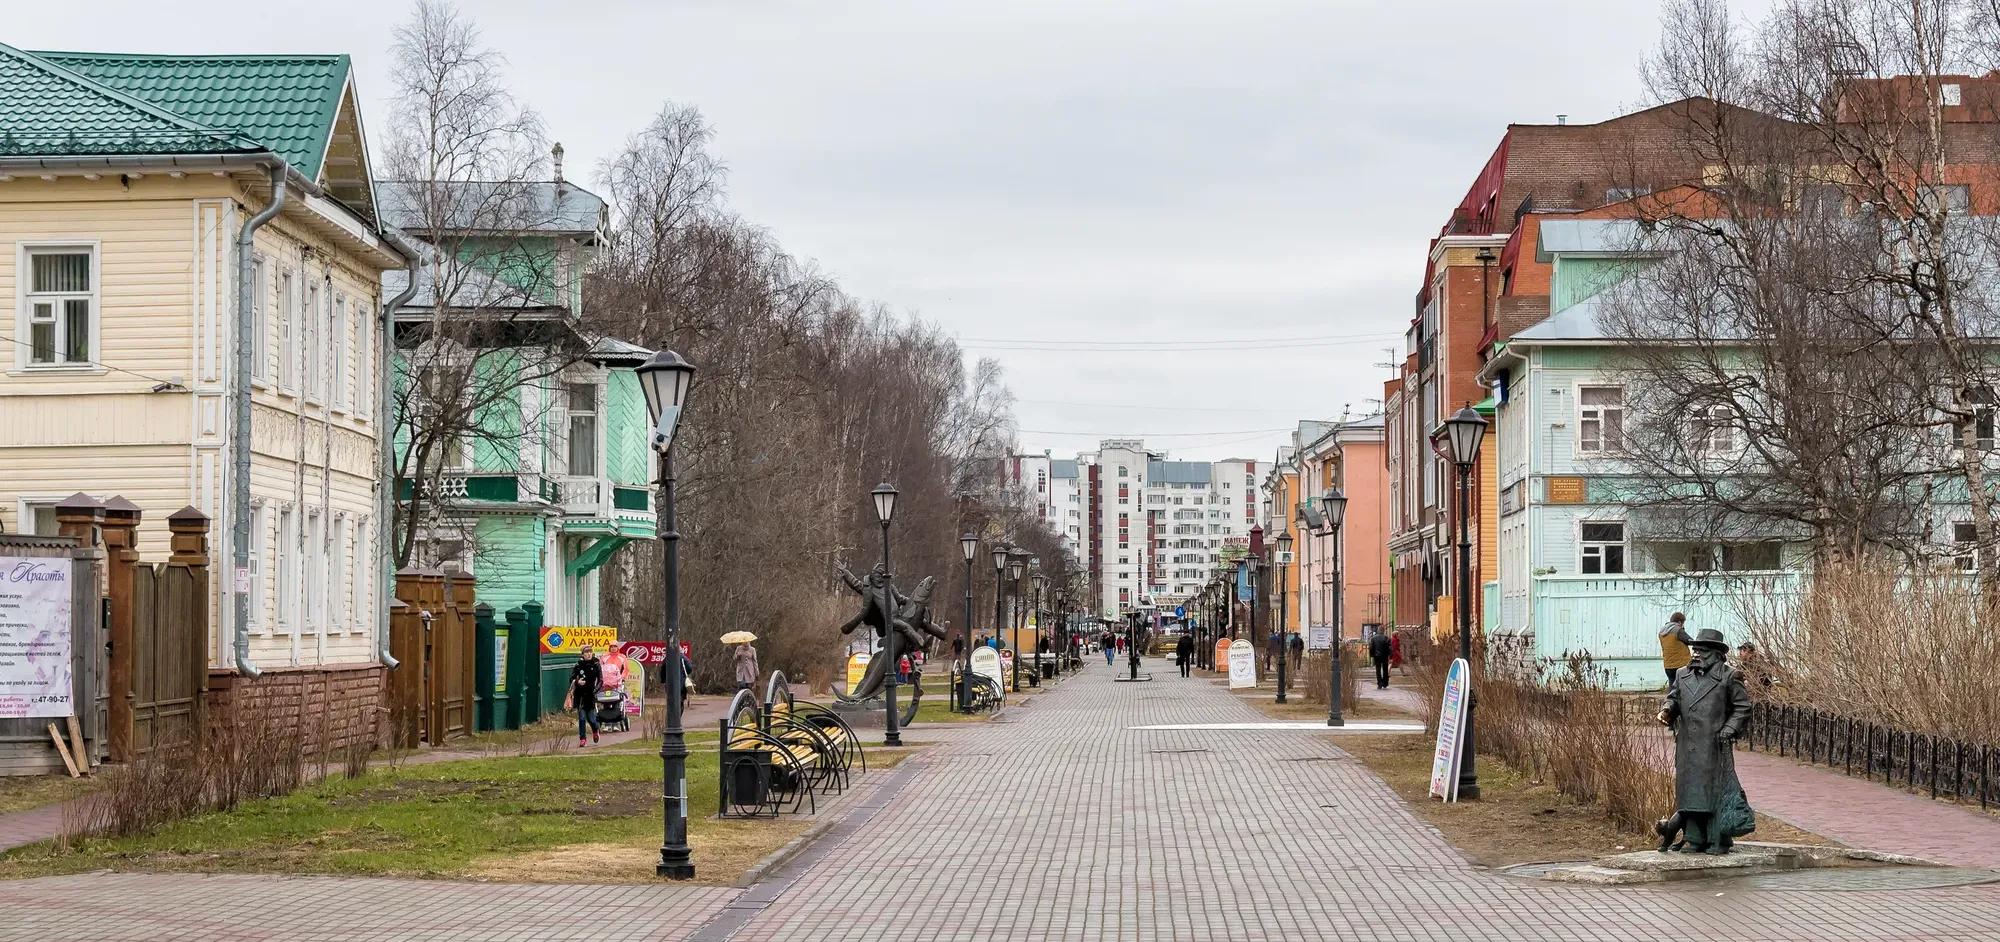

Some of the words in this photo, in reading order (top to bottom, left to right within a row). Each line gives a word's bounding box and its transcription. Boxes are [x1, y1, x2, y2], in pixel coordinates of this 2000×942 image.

[10, 561, 65, 584] Красоты
[566, 628, 615, 638] ЛЫЖНАЯ
[569, 638, 611, 648] ЛАВКА
